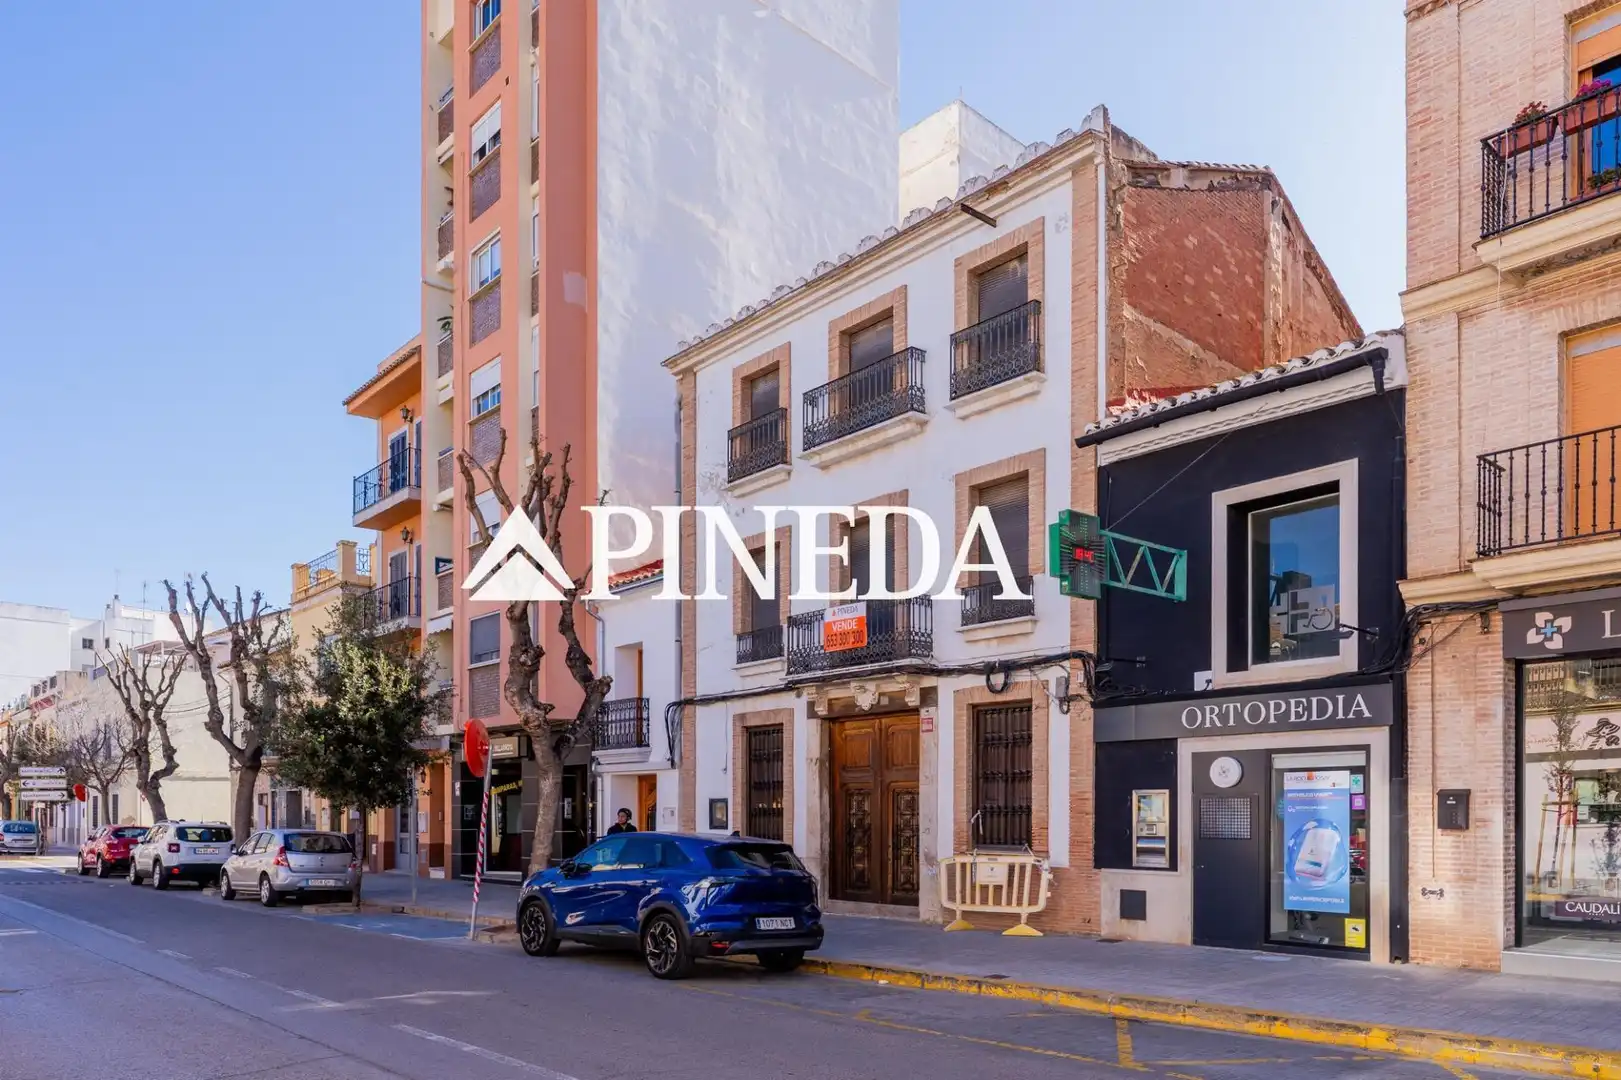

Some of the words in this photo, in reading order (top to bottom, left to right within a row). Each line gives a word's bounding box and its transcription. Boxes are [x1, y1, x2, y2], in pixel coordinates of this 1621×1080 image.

[836, 605, 859, 617] PINEDA
[832, 619, 858, 632] VENDE
[1181, 693, 1373, 730] ORTOPEDIA
